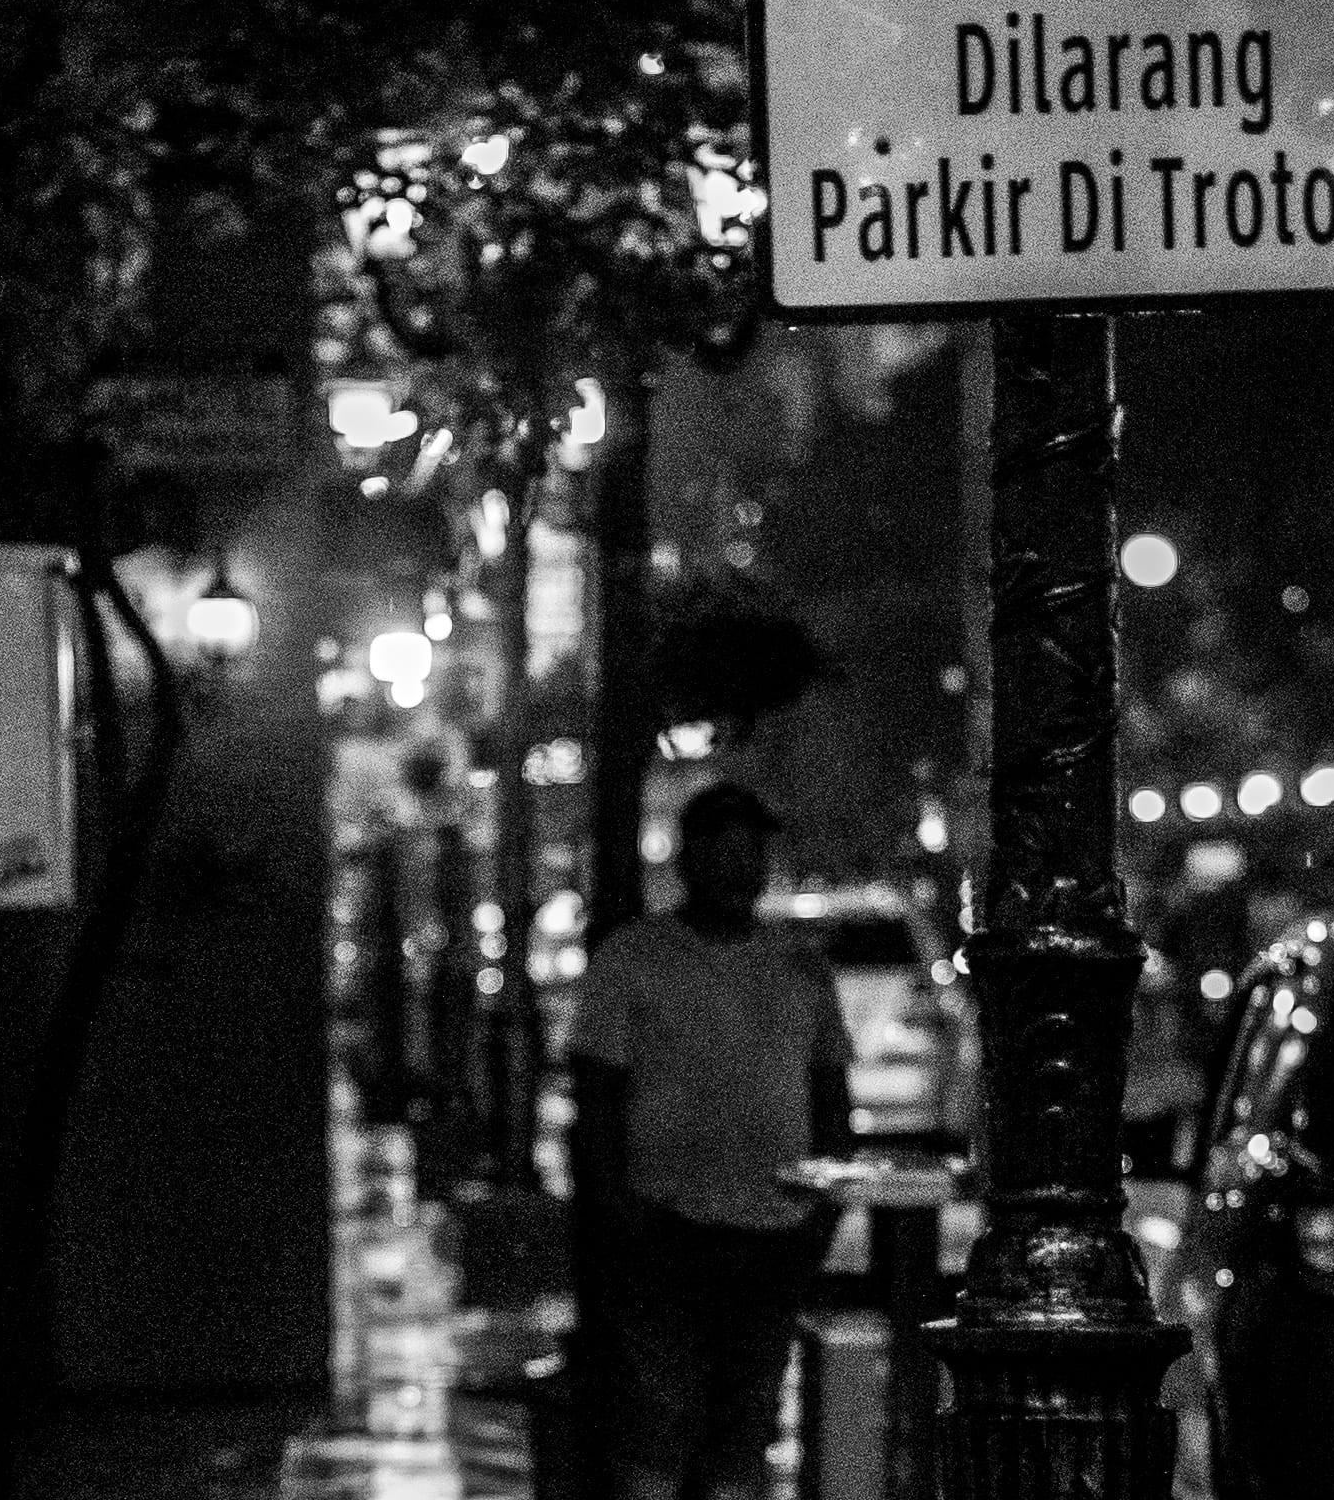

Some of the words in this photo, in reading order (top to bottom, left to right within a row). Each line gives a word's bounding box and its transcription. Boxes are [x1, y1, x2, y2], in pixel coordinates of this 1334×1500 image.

[954, 9, 1276, 137] Dilarang
[810, 153, 1033, 262] Parkir
[1057, 148, 1128, 256] Di
